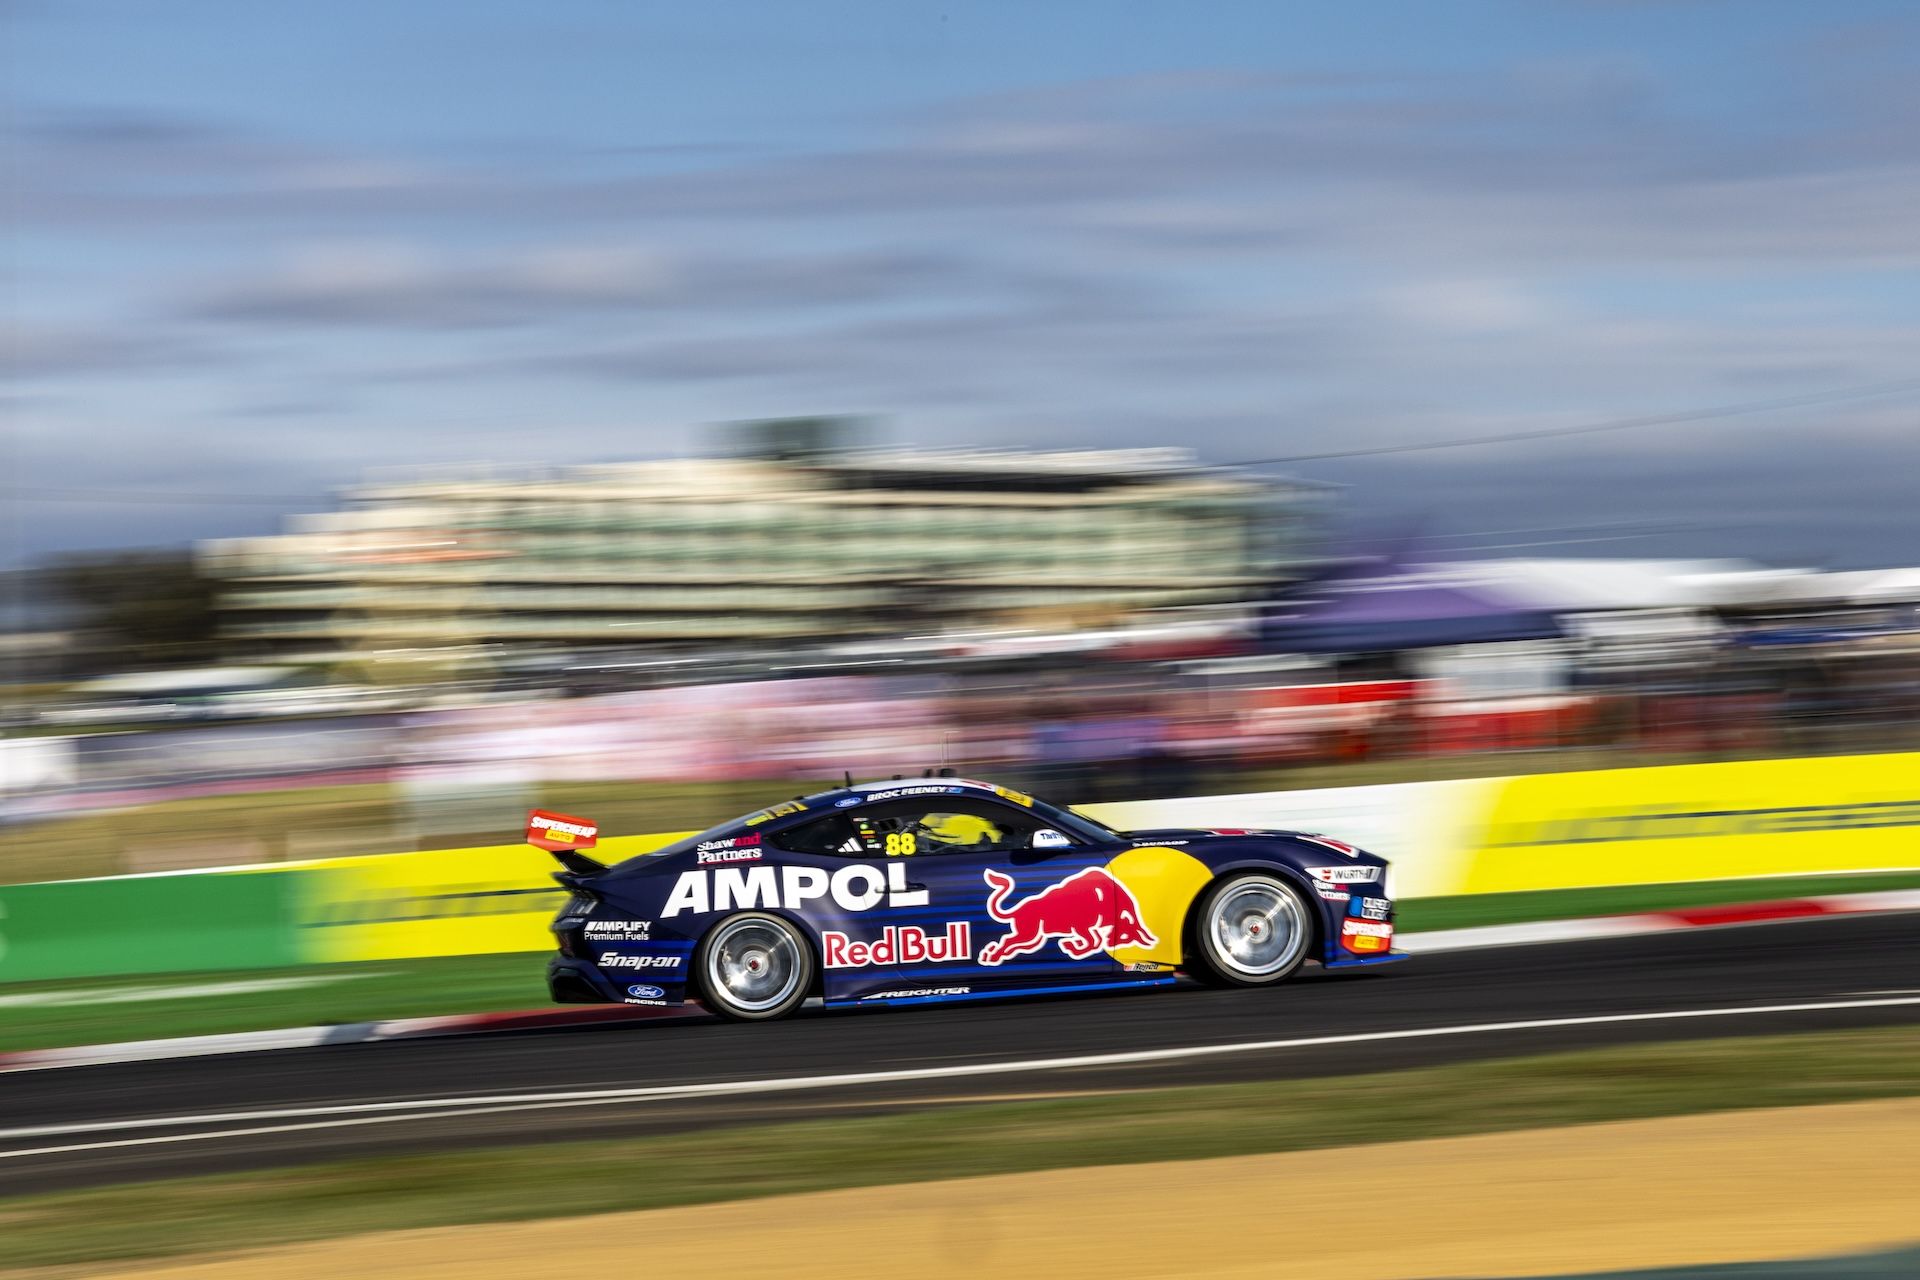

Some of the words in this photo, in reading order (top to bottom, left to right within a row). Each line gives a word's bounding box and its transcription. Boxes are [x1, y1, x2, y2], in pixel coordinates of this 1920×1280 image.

[867, 789, 900, 802] BROC
[901, 786, 946, 796] FEENEY
[531, 816, 598, 838] SUPERCHEAP
[548, 831, 572, 842] AUTO
[886, 832, 917, 857] 88
[697, 848, 763, 864] Partners
[660, 862, 929, 918] AMPOL
[594, 921, 651, 931] AMPLIFY
[584, 931, 623, 941] Premium
[625, 931, 650, 941] Fuels
[823, 926, 897, 968] Red
[900, 922, 970, 960] Bull
[598, 952, 681, 970] Snap-on
[633, 986, 658, 997] Ford
[864, 987, 970, 999] FREIGHTER
[624, 998, 667, 1006] RACING
